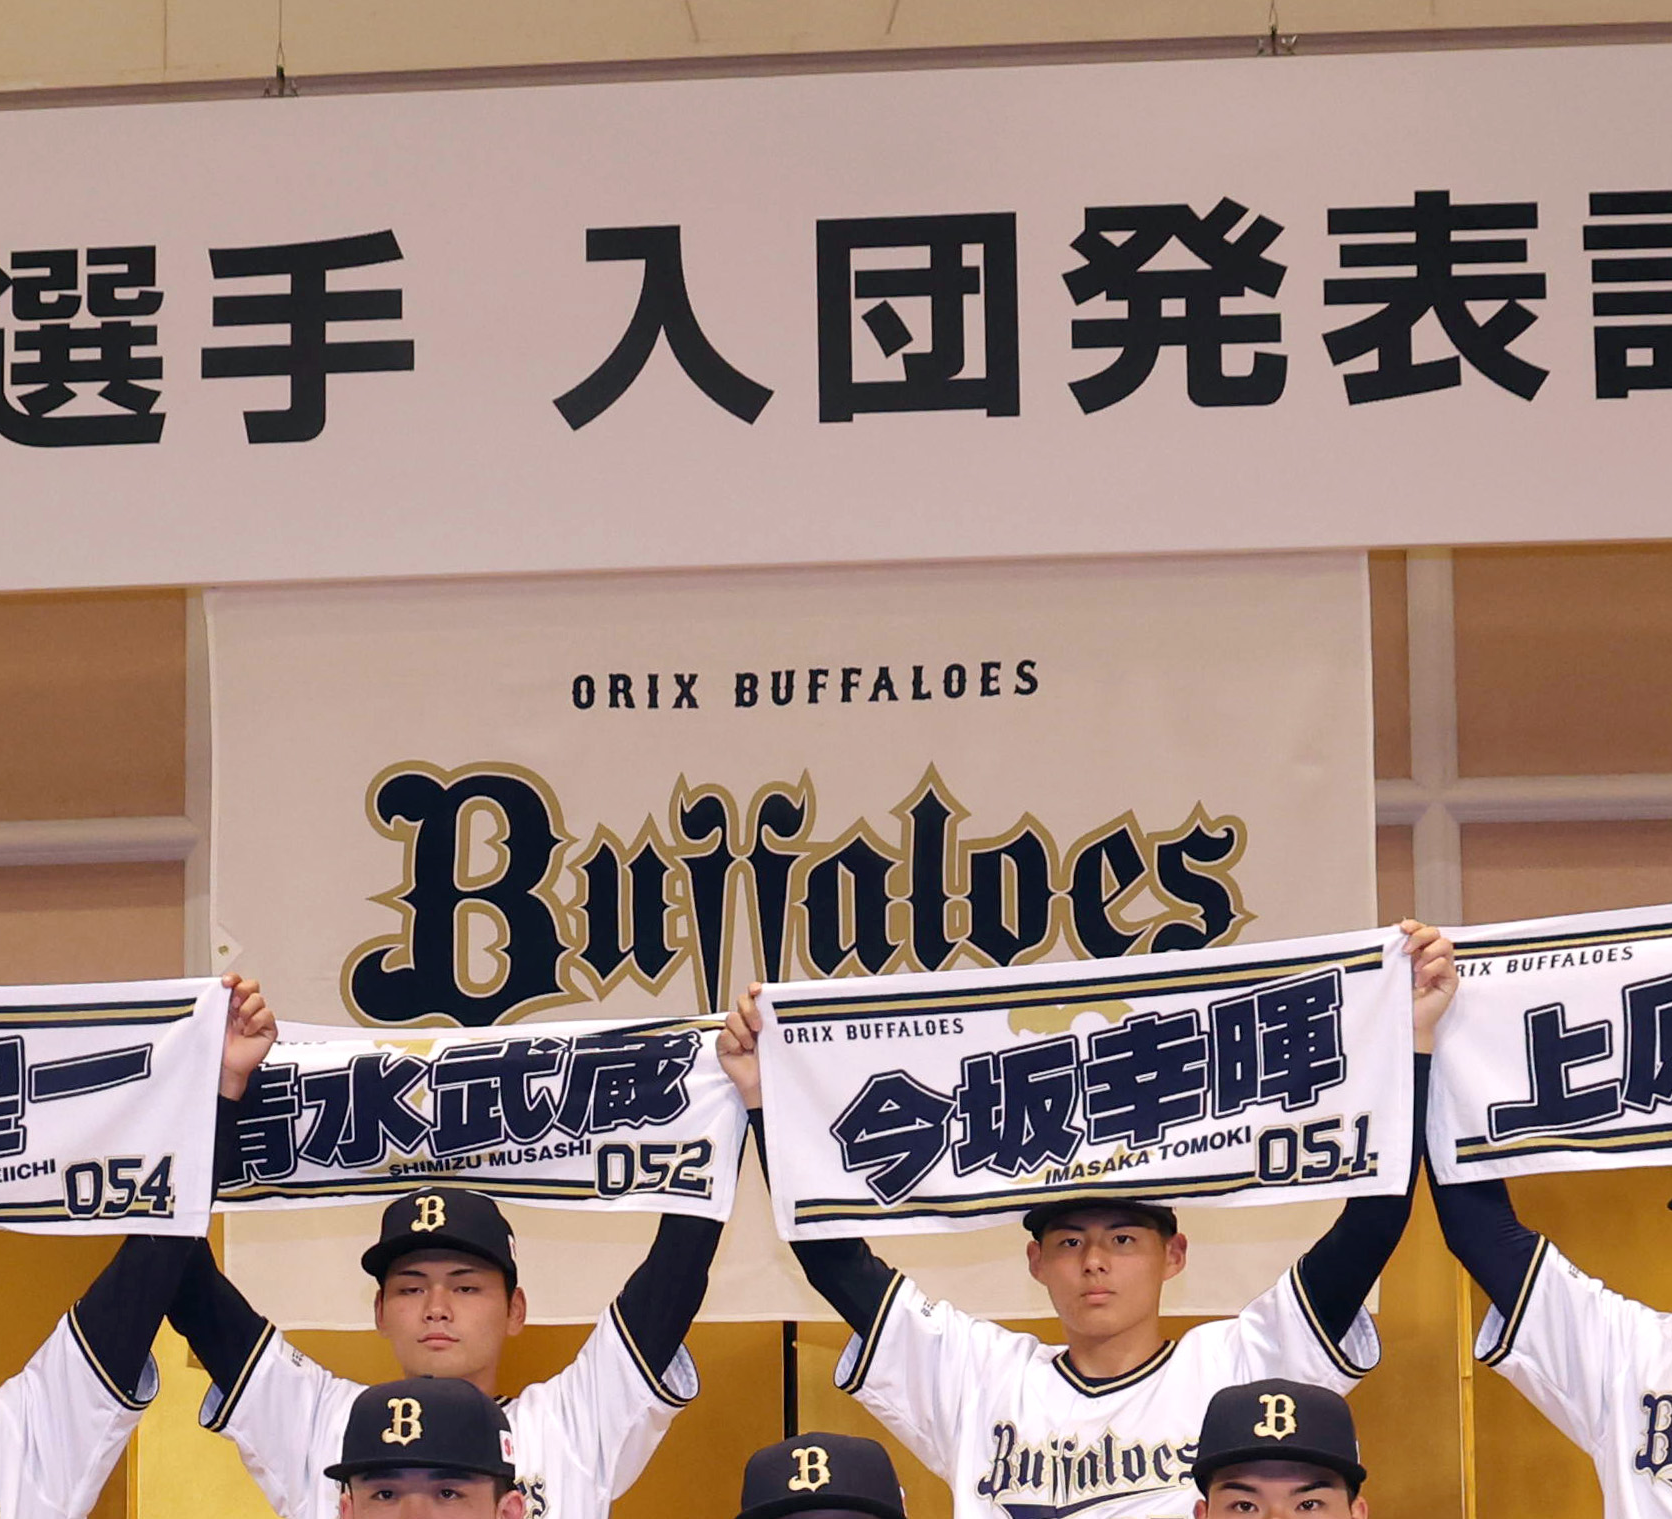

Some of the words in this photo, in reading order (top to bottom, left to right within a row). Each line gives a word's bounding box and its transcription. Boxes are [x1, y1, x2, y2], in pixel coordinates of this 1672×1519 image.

[572, 669, 699, 710] ORIX
[734, 659, 1040, 709] BUFFALOES
[339, 760, 1258, 1026] Buffaloes
[1455, 960, 1492, 978] RIX
[1506, 946, 1634, 974] BUFFALOES
[782, 1024, 834, 1044] ORIX
[845, 1017, 965, 1041] BUFFALOES
[389, 1154, 482, 1177] SHIMIZU
[488, 1138, 592, 1167] MUSASHI
[595, 1138, 715, 1200] 052
[1044, 1149, 1152, 1186] IMASAKA
[1157, 1126, 1252, 1161] TOMOKI
[1253, 1112, 1378, 1183] 051
[62, 1152, 176, 1219] 054
[410, 1195, 447, 1233] B
[382, 1397, 425, 1446] B
[1253, 1393, 1297, 1441] B
[788, 1446, 830, 1491] B
[976, 1420, 1200, 1506] Buffaloes
